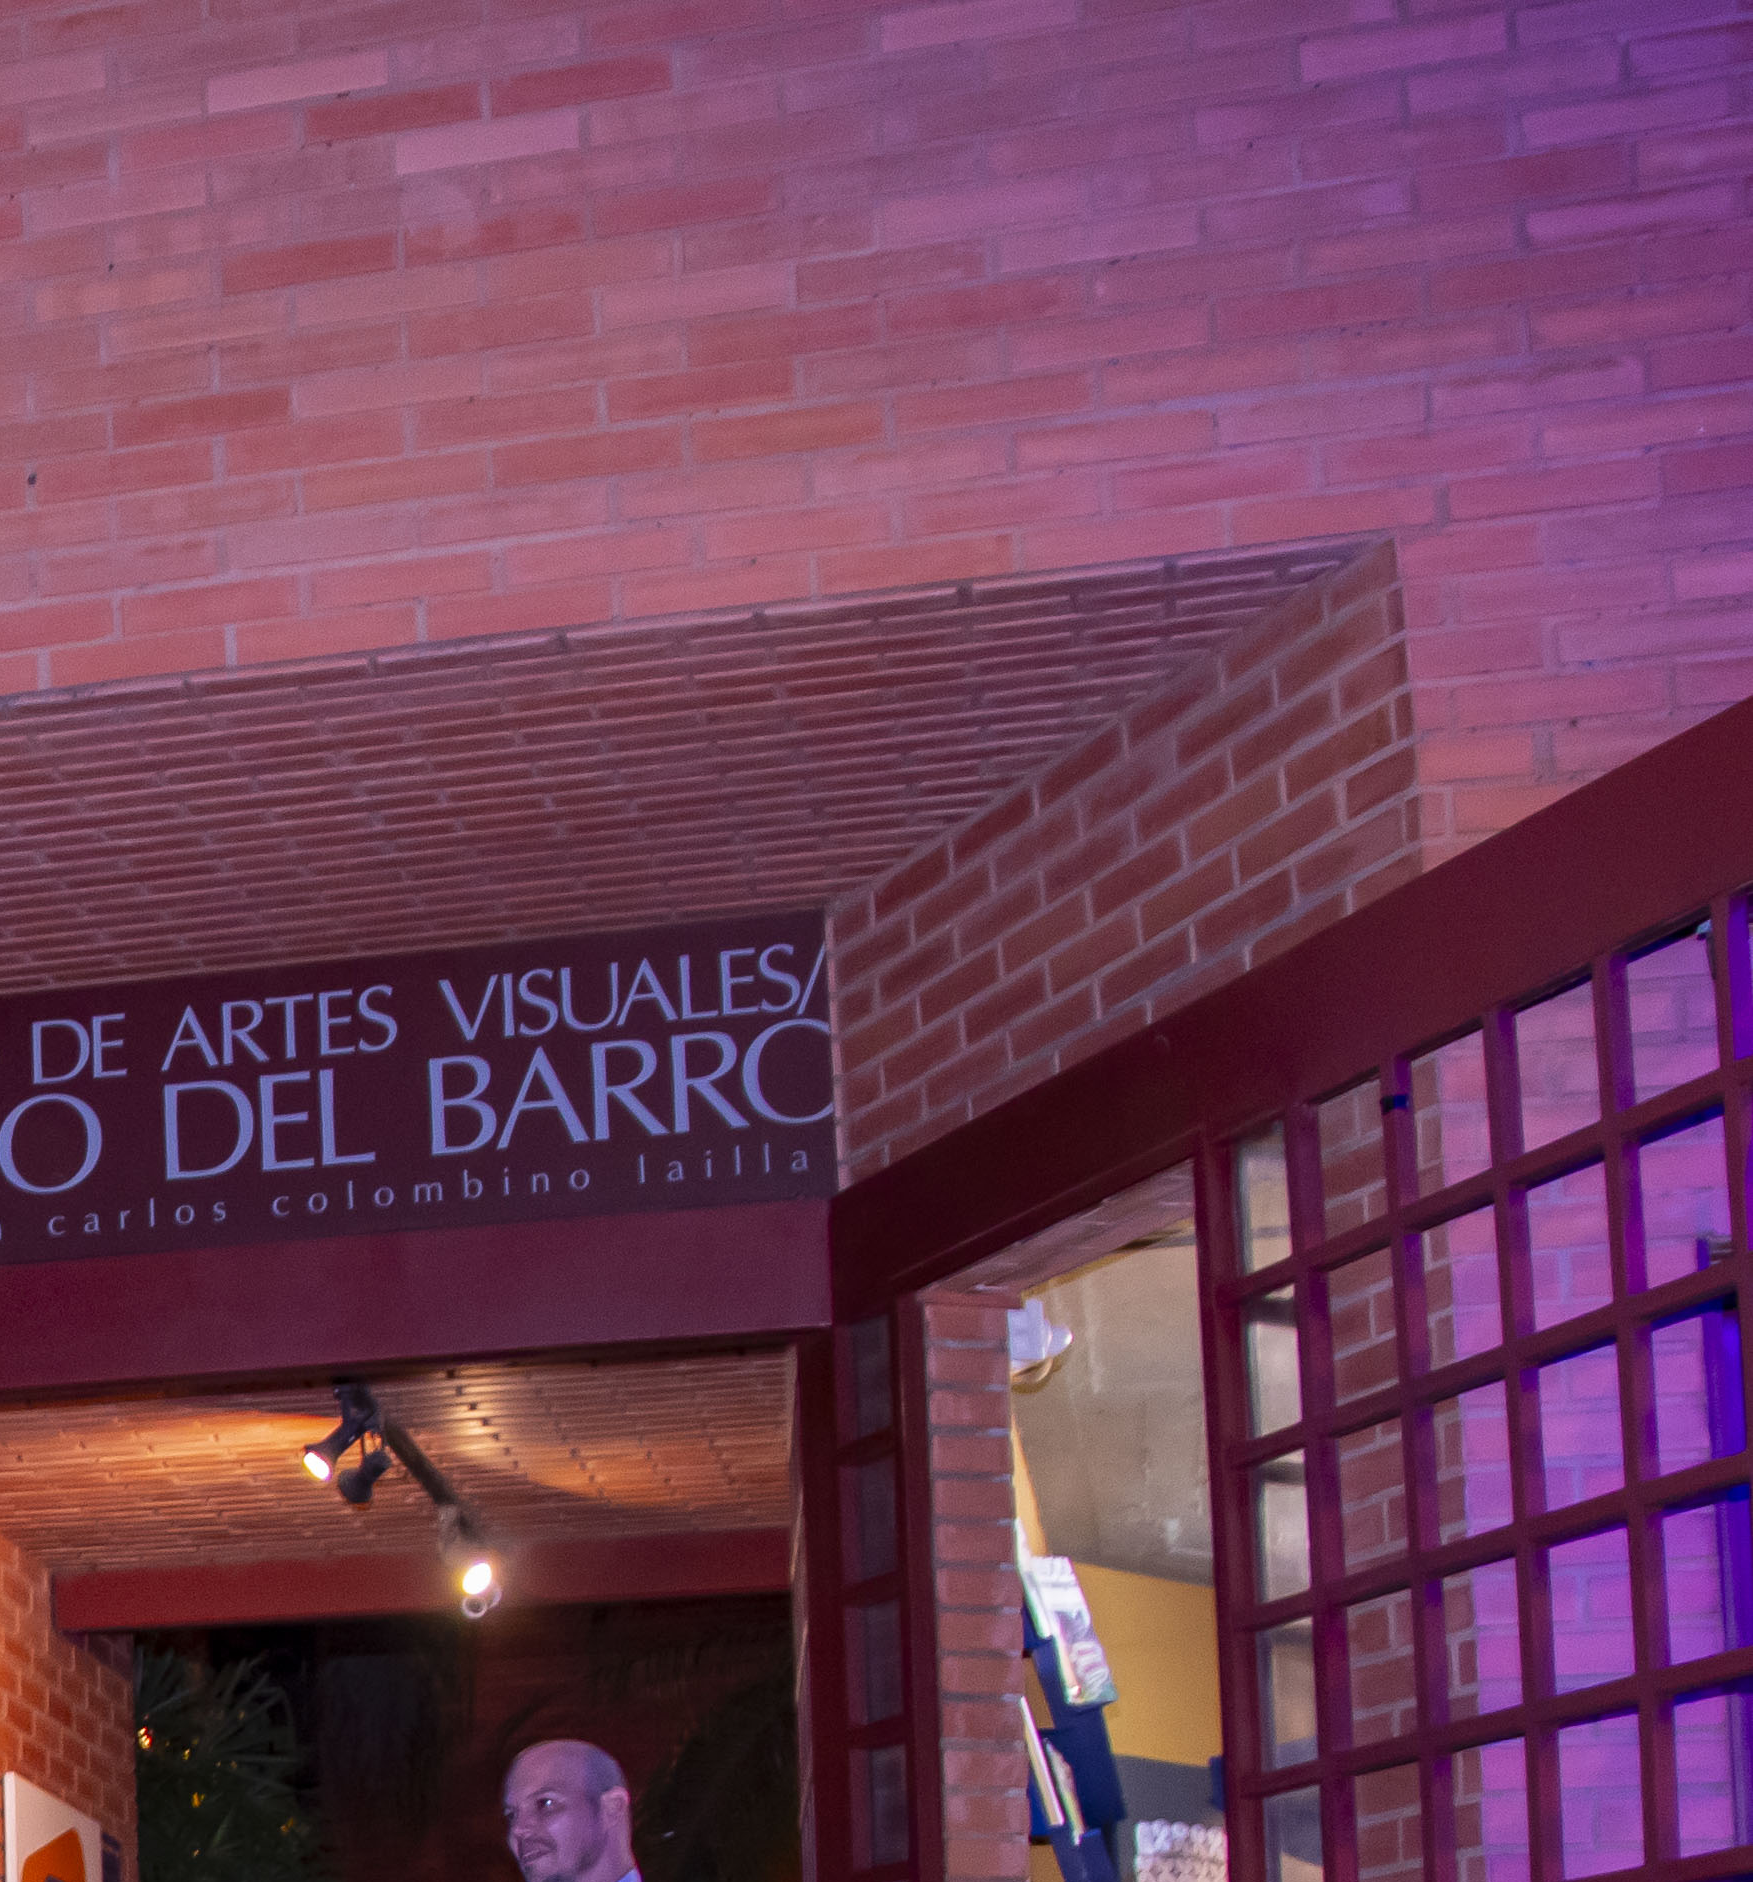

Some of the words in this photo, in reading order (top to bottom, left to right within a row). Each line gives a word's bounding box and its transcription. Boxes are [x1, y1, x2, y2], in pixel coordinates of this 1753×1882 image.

[32, 1013, 127, 1085] DE
[161, 985, 397, 1072] ARTES
[164, 1068, 376, 1180] DEL
[49, 1196, 226, 1237] carlos
[272, 1168, 590, 1217] colombino
[638, 1141, 808, 1184] lailla
